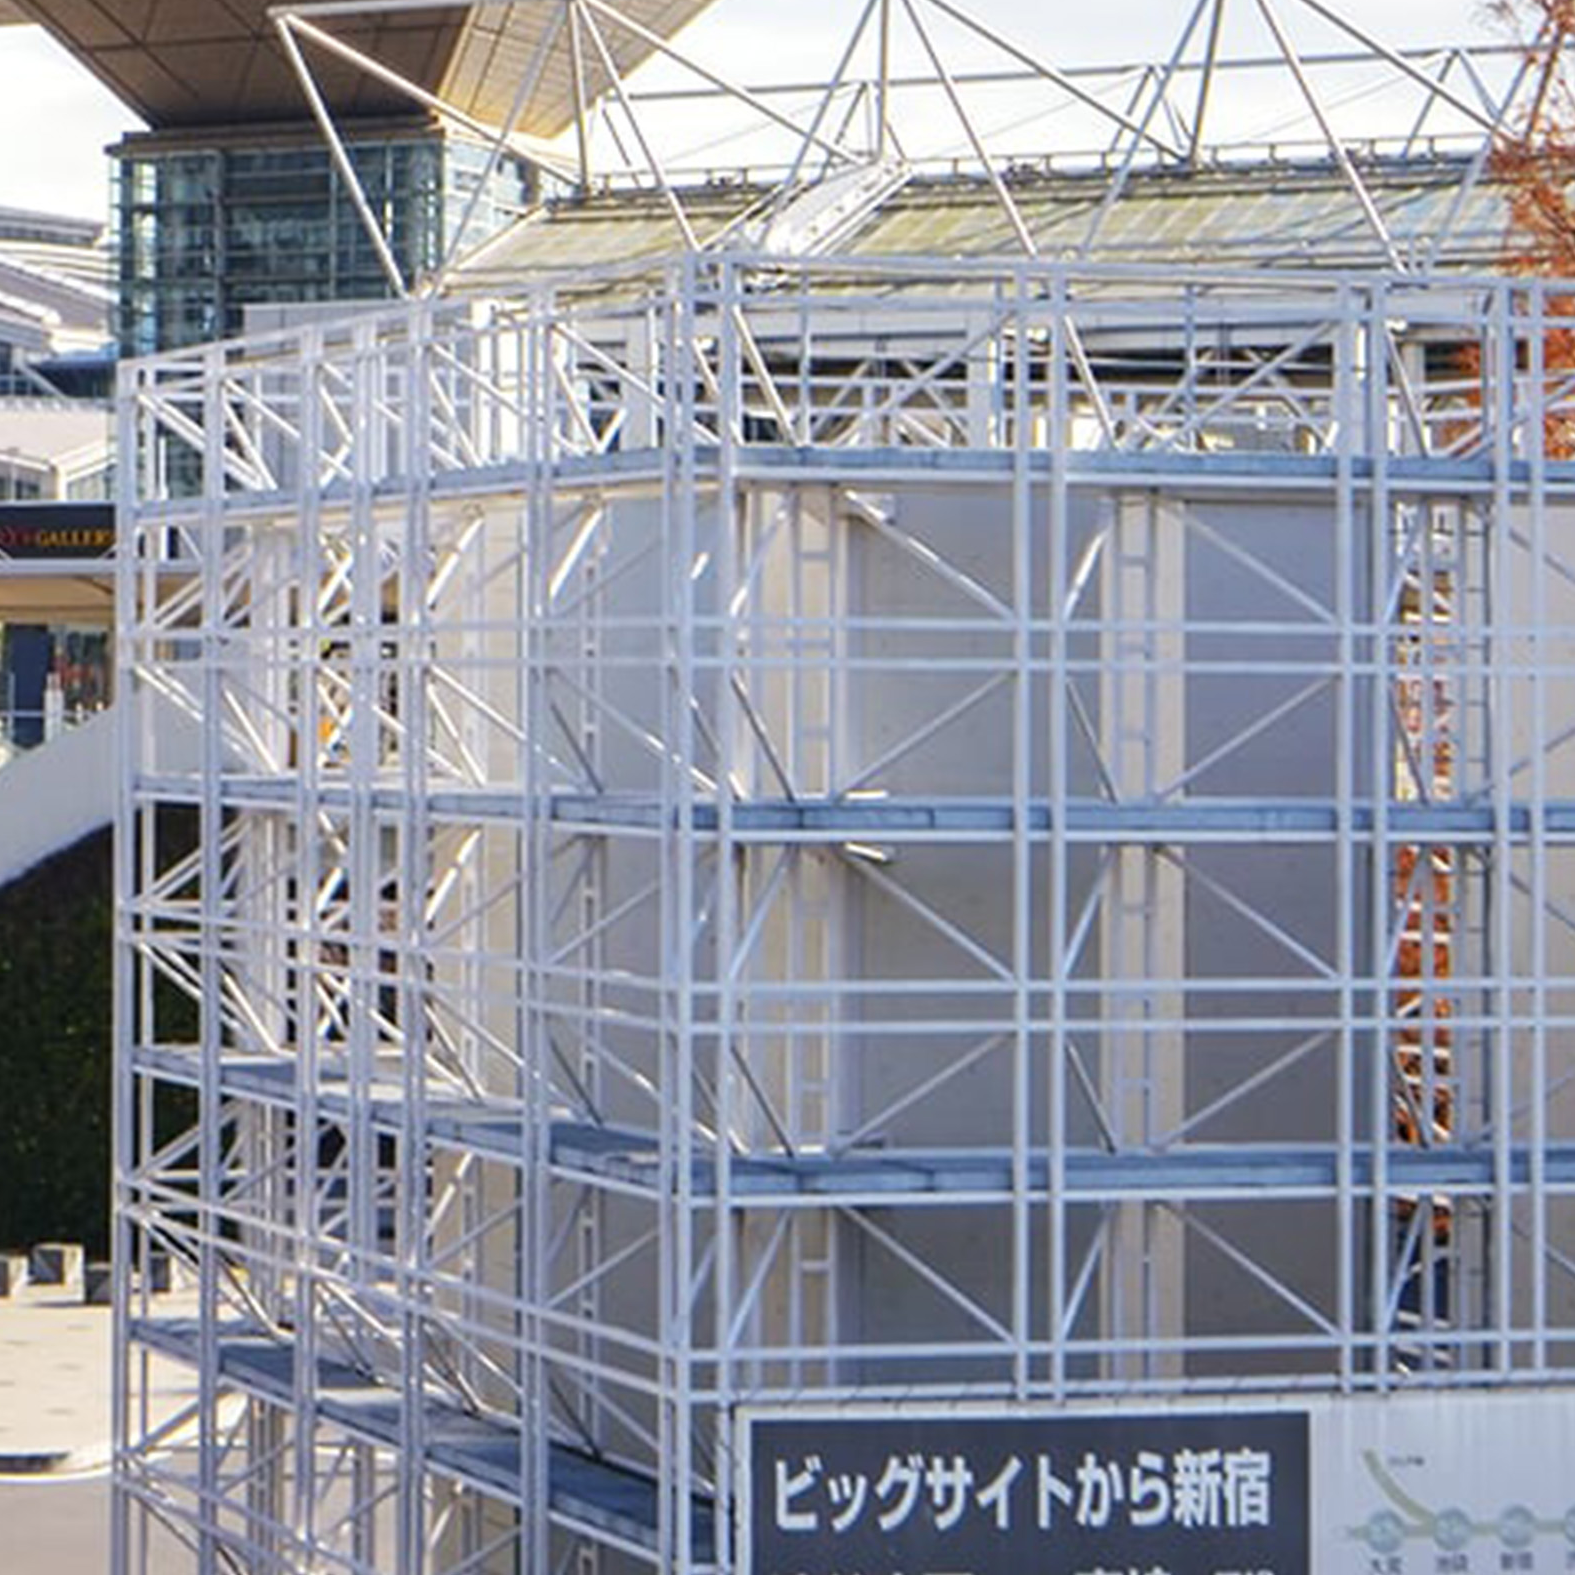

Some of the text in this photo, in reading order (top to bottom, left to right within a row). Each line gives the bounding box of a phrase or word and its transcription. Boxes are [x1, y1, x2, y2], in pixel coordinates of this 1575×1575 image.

[774, 1446, 1271, 1532] ビッグサイトから新宿
